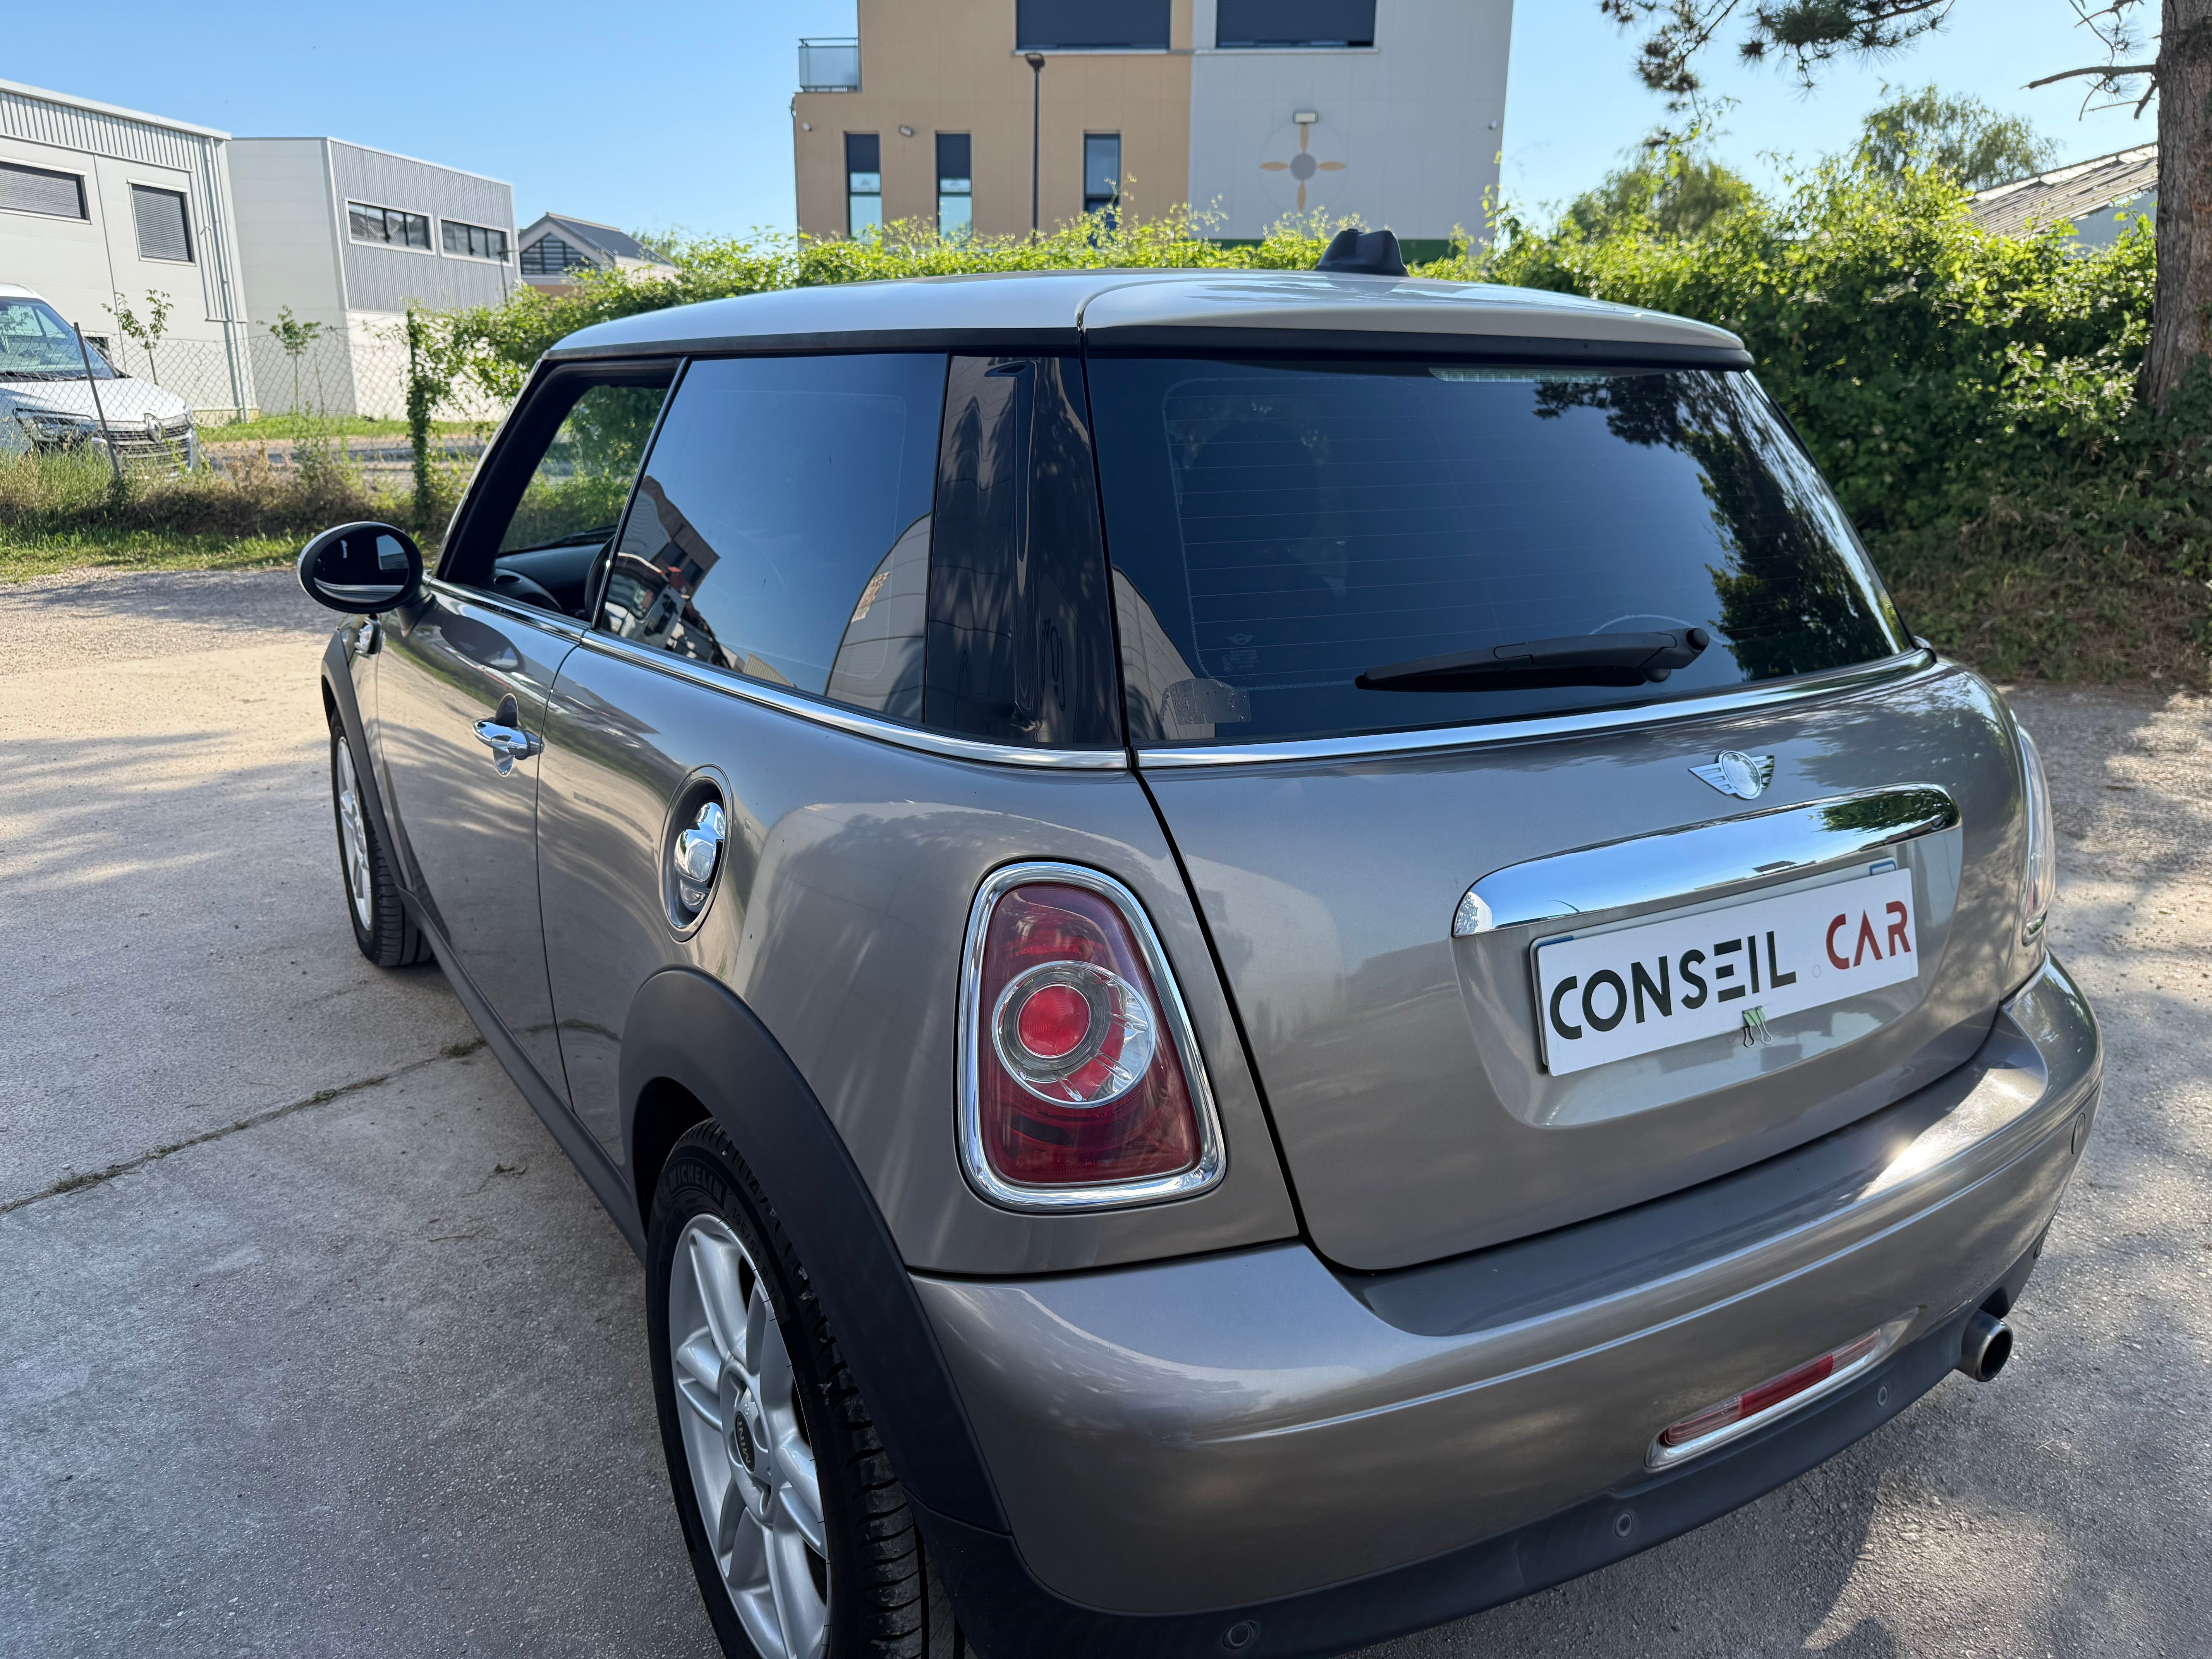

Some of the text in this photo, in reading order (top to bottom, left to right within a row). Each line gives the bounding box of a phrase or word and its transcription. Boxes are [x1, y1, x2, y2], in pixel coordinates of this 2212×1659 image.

[1549, 900, 1911, 1040] CONSEIL CAR
[669, 1164, 723, 1202] MICHELIN
[733, 1208, 779, 1307] 195/55 R 16
[738, 1421, 750, 1463] MINI
